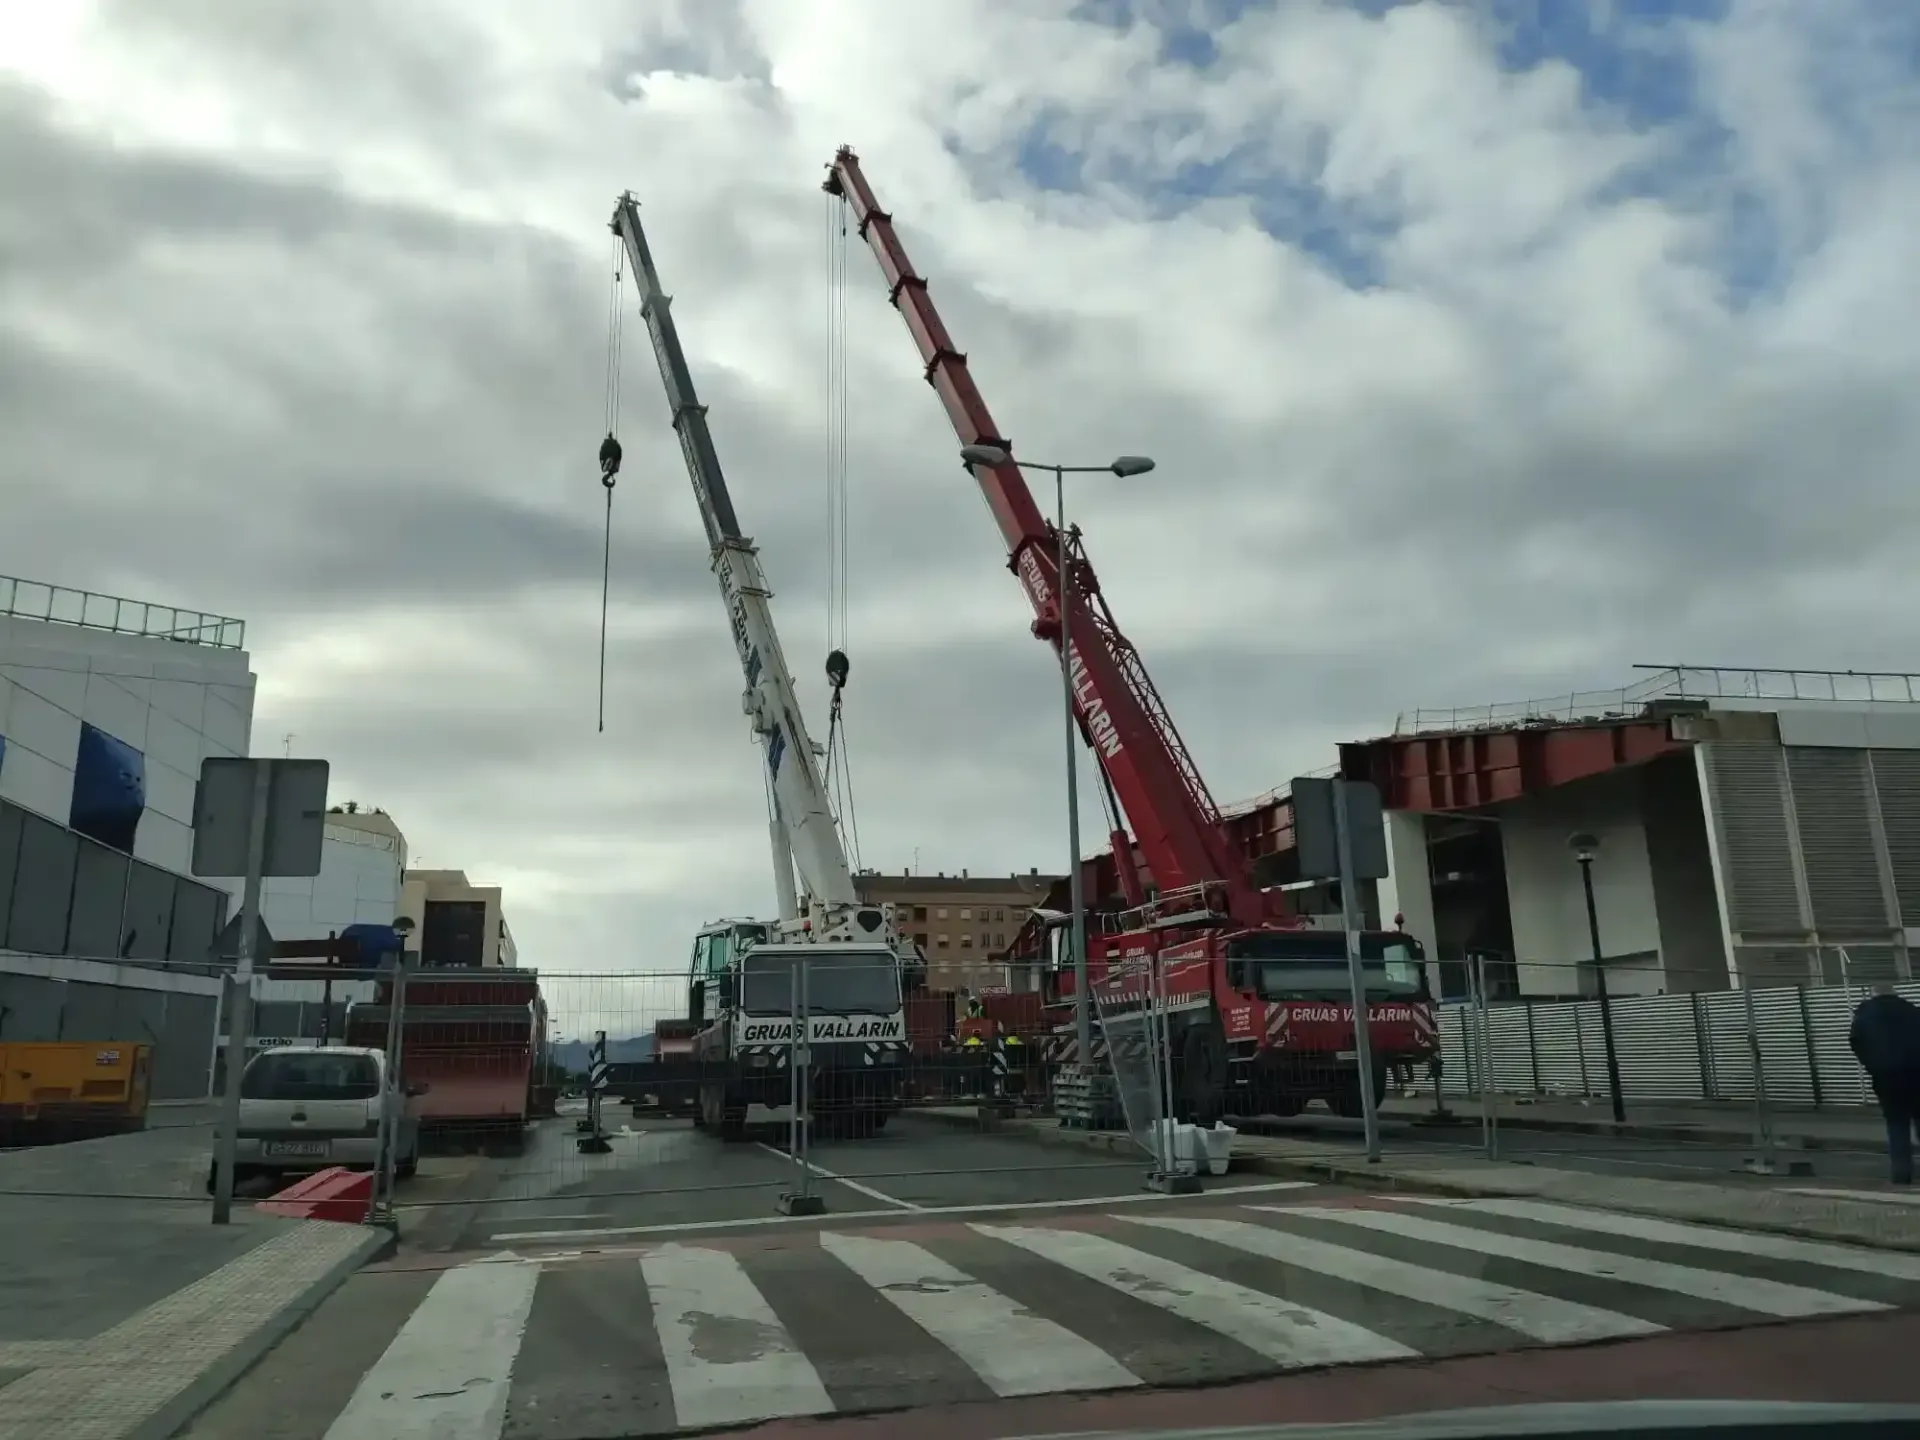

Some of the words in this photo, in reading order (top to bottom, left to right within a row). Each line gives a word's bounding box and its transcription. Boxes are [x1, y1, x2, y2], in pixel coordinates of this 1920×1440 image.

[1020, 547, 1050, 602] GRUAS
[1292, 1008, 1338, 1021] GRUAS
[1343, 1008, 1411, 1022] VLARIN
[744, 1024, 804, 1041] GRUAS
[813, 1021, 899, 1039] VALLARIN
